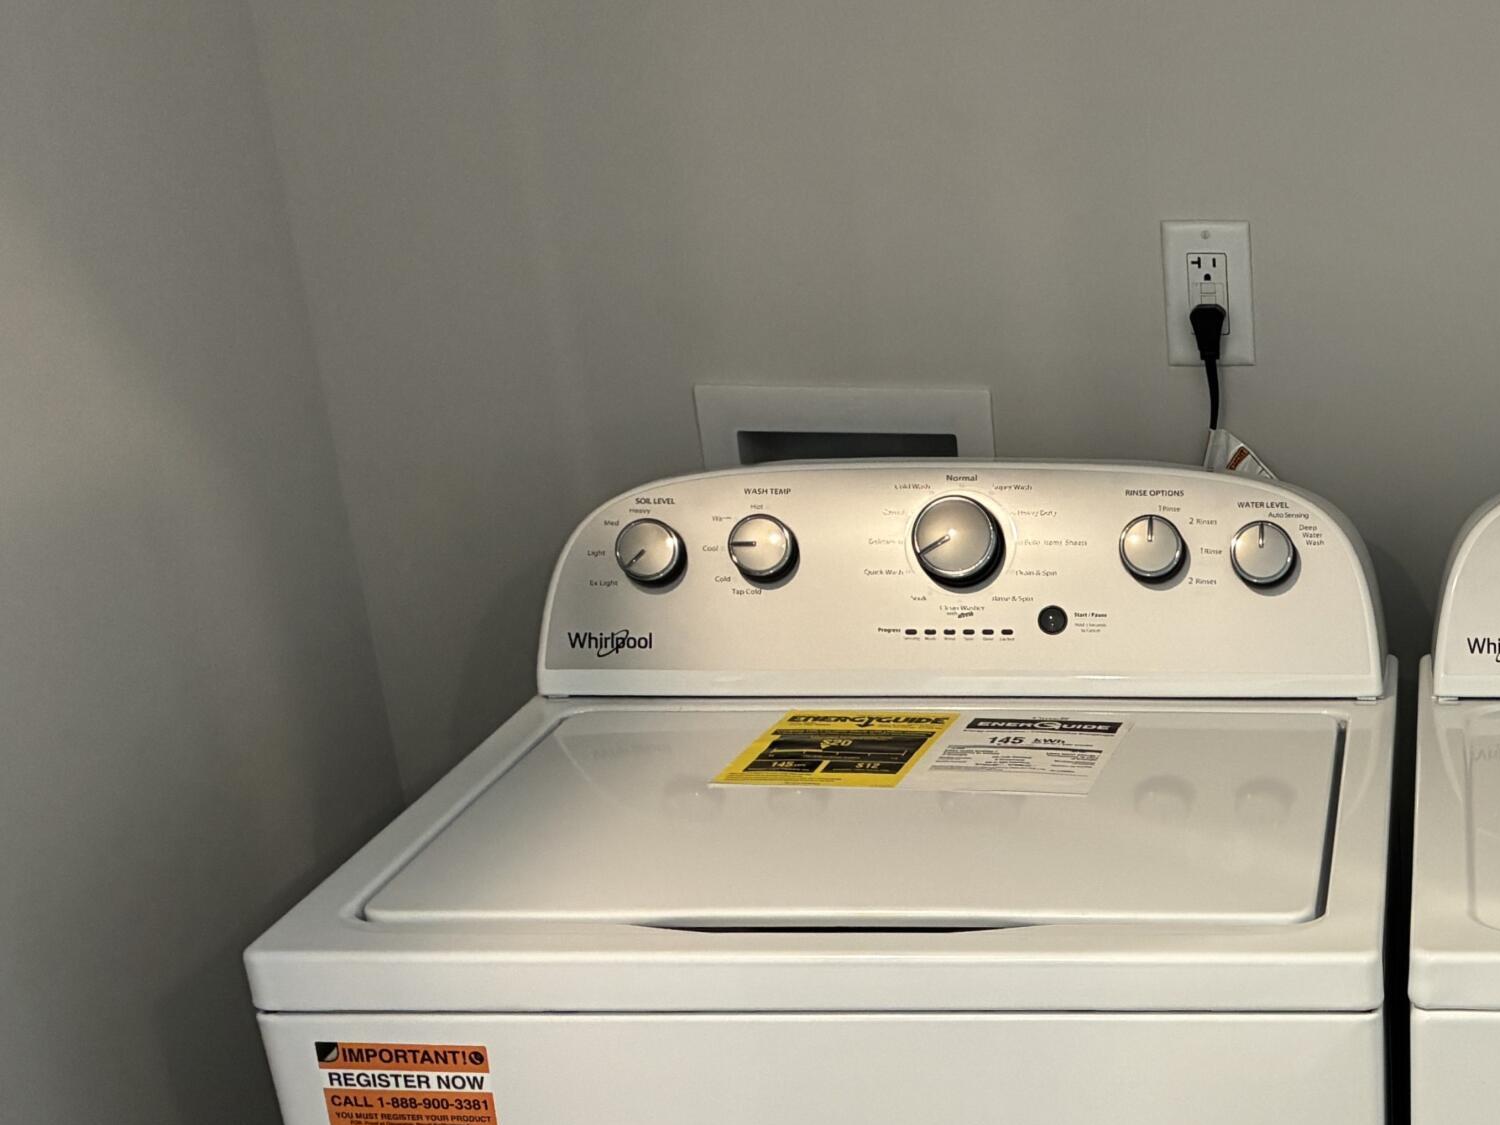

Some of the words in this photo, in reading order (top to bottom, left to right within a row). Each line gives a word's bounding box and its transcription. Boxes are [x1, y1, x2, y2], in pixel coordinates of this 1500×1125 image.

[946, 474, 978, 482] Normal
[1125, 489, 1148, 497] RINSE
[1149, 489, 1184, 497] OPTIONS
[1162, 505, 1181, 513] Rinse
[1237, 501, 1265, 509] WATER
[1266, 501, 1289, 509] LEVEL
[1285, 512, 1309, 520] Sensing
[1189, 517, 1195, 525] 2
[1196, 518, 1218, 526] Rinses
[1299, 524, 1317, 533] Deep
[1302, 531, 1322, 539] Water
[1188, 577, 1194, 585] 2
[732, 588, 745, 596] Tap
[567, 630, 653, 657] Whirlpool
[787, 715, 950, 726] ENERGYGUIDE
[988, 736, 1025, 744] 145
[342, 1047, 467, 1065] IMPORTANT!
[328, 1072, 430, 1089] REGISTER
[438, 1076, 484, 1090] NOW
[331, 1095, 374, 1108] CALL
[377, 1097, 489, 1111] 1-888-900-3381
[335, 1111, 354, 1120] YOU
[357, 1112, 379, 1121] MUST
[381, 1113, 424, 1122] REGISTER
[425, 1114, 449, 1122] YOUR
[450, 1115, 491, 1123] PRODUCT
